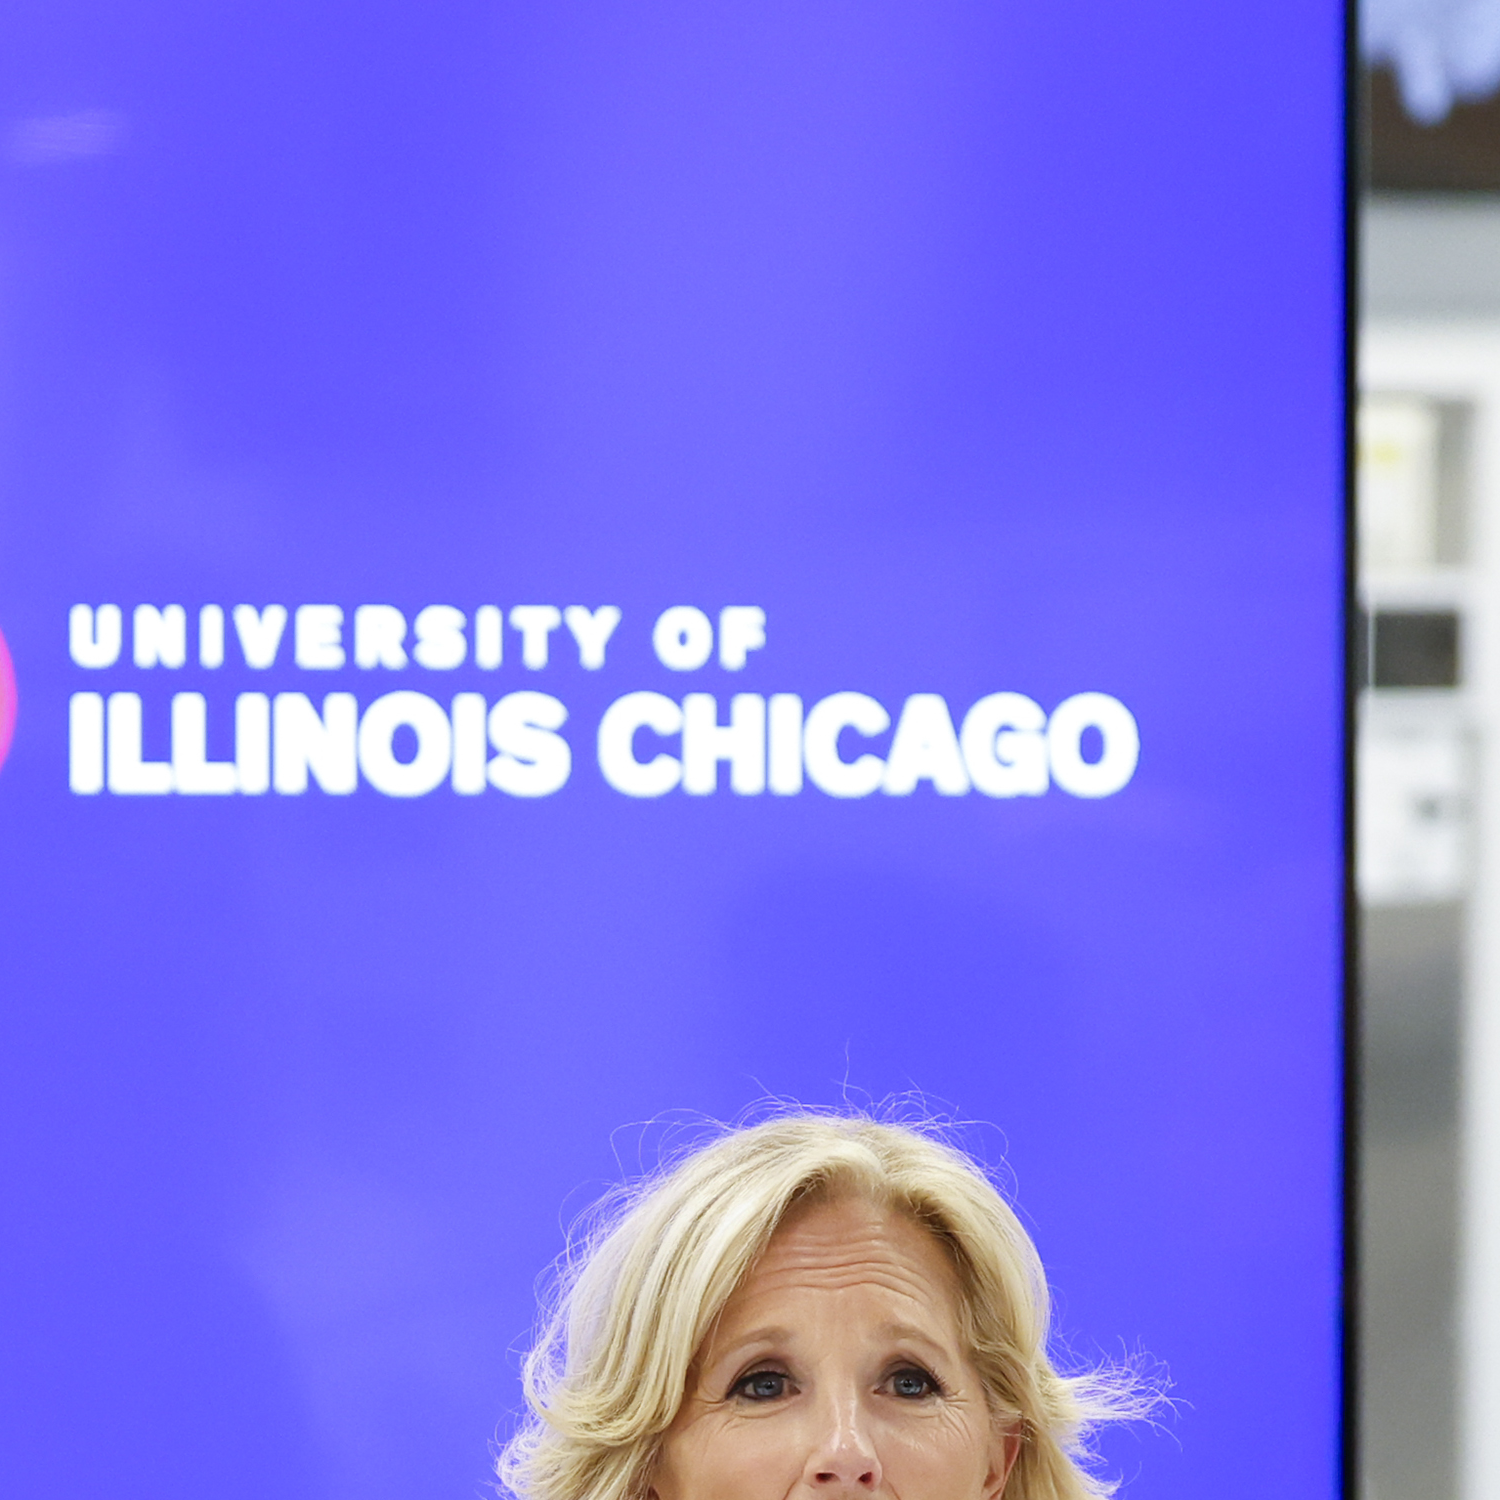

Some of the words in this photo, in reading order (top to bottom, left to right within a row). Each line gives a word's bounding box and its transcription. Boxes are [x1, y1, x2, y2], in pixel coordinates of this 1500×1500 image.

[70, 604, 620, 670] UNIVERSITY
[652, 605, 766, 671] OF
[70, 691, 572, 798] ILLINOIS
[597, 691, 1140, 798] CHICAGO
